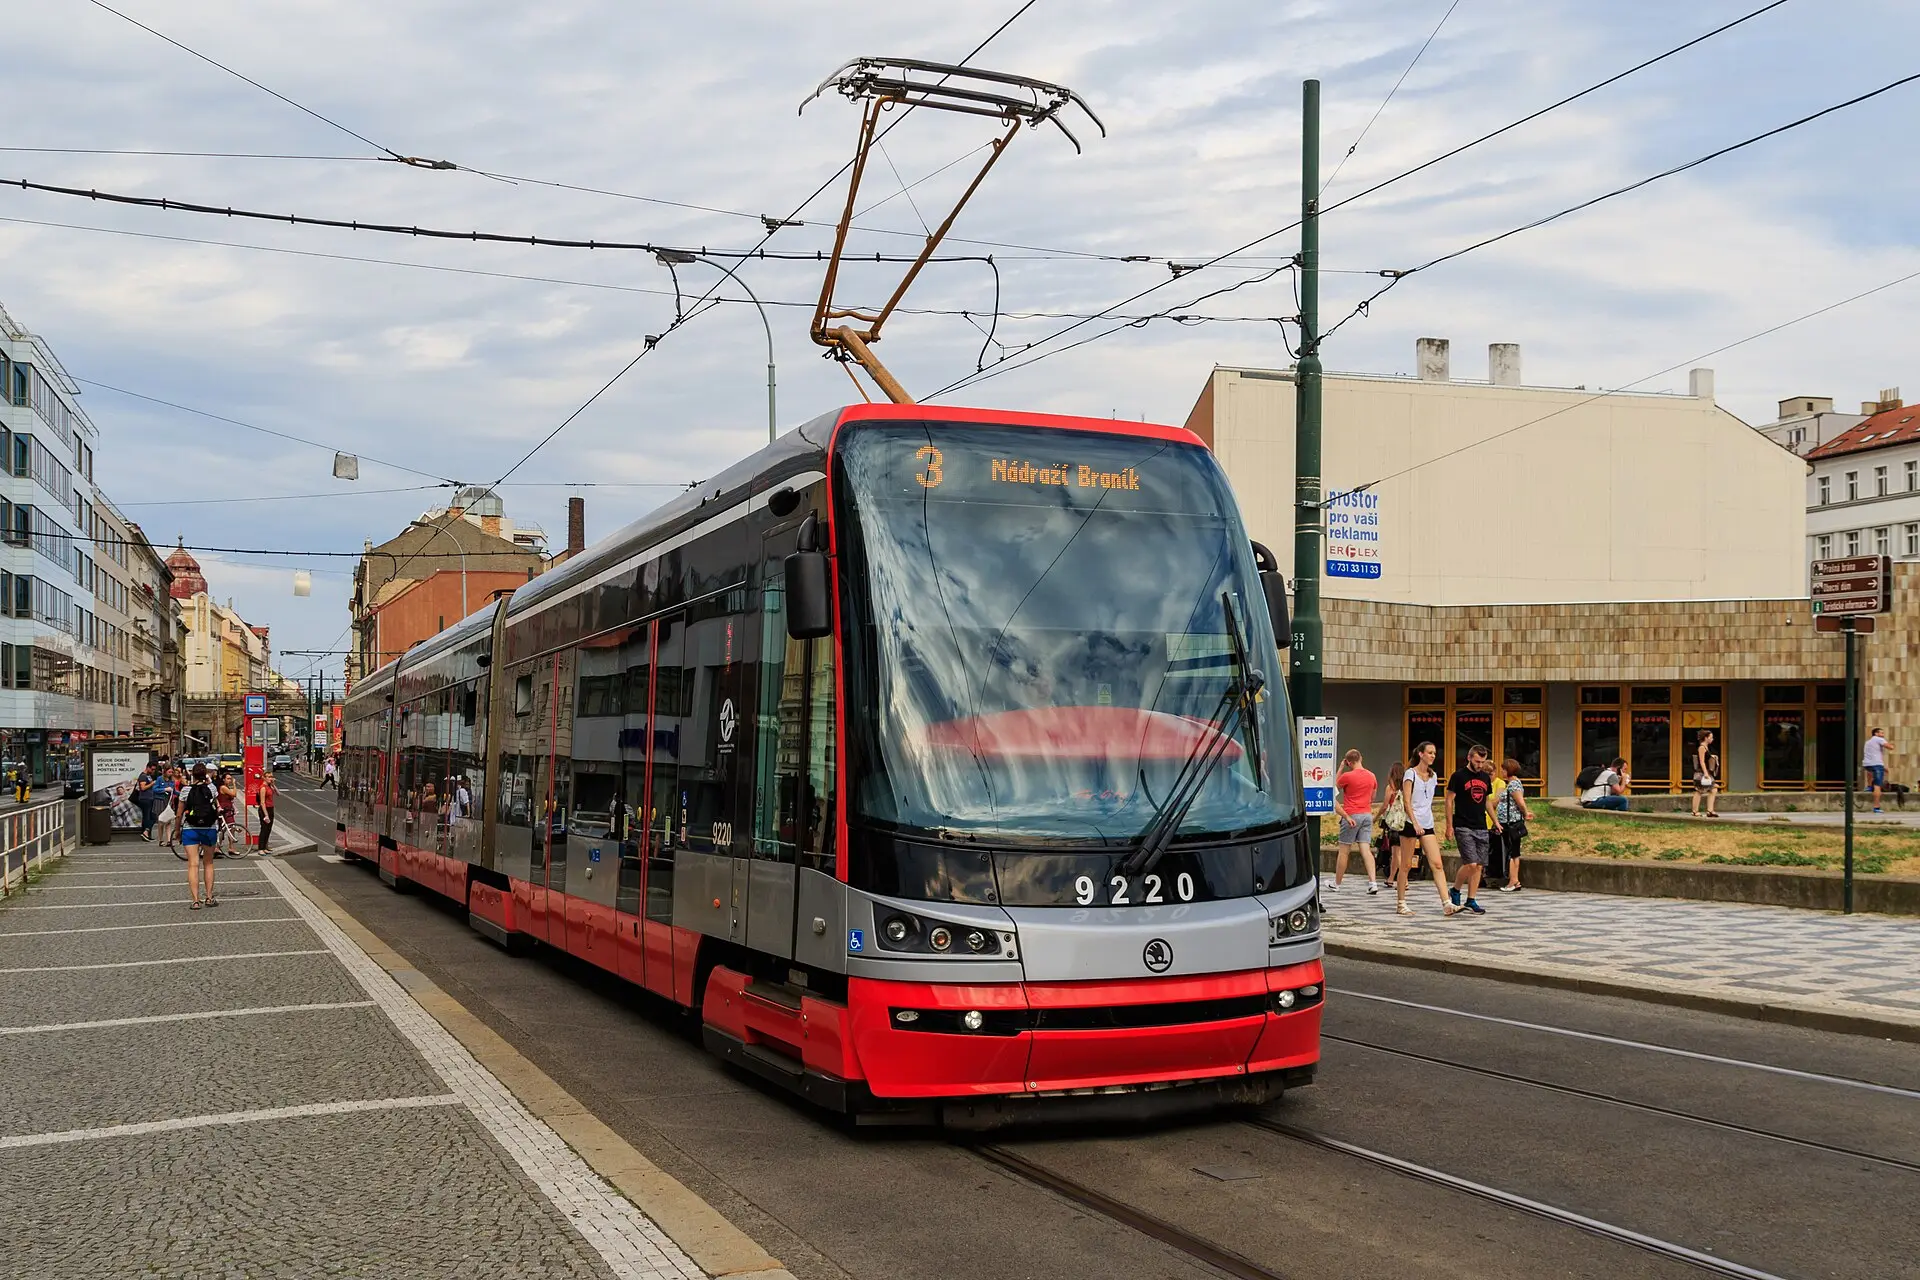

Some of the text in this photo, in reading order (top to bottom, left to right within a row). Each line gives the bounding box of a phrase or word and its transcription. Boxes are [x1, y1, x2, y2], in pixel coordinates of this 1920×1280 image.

[915, 446, 1140, 490] 3 Nádraží Braník
[1329, 491, 1378, 509] prostor
[1329, 512, 1378, 525] pro vaši
[1329, 526, 1378, 541] reklamu
[1337, 562, 1379, 574] 731 33 11 33
[1294, 642, 1304, 650] 41
[1304, 725, 1333, 736] prostor
[1304, 740, 1318, 749] pro
[1304, 750, 1333, 759] reklamu
[713, 822, 732, 846] 9220
[1074, 872, 1194, 905] 9220
